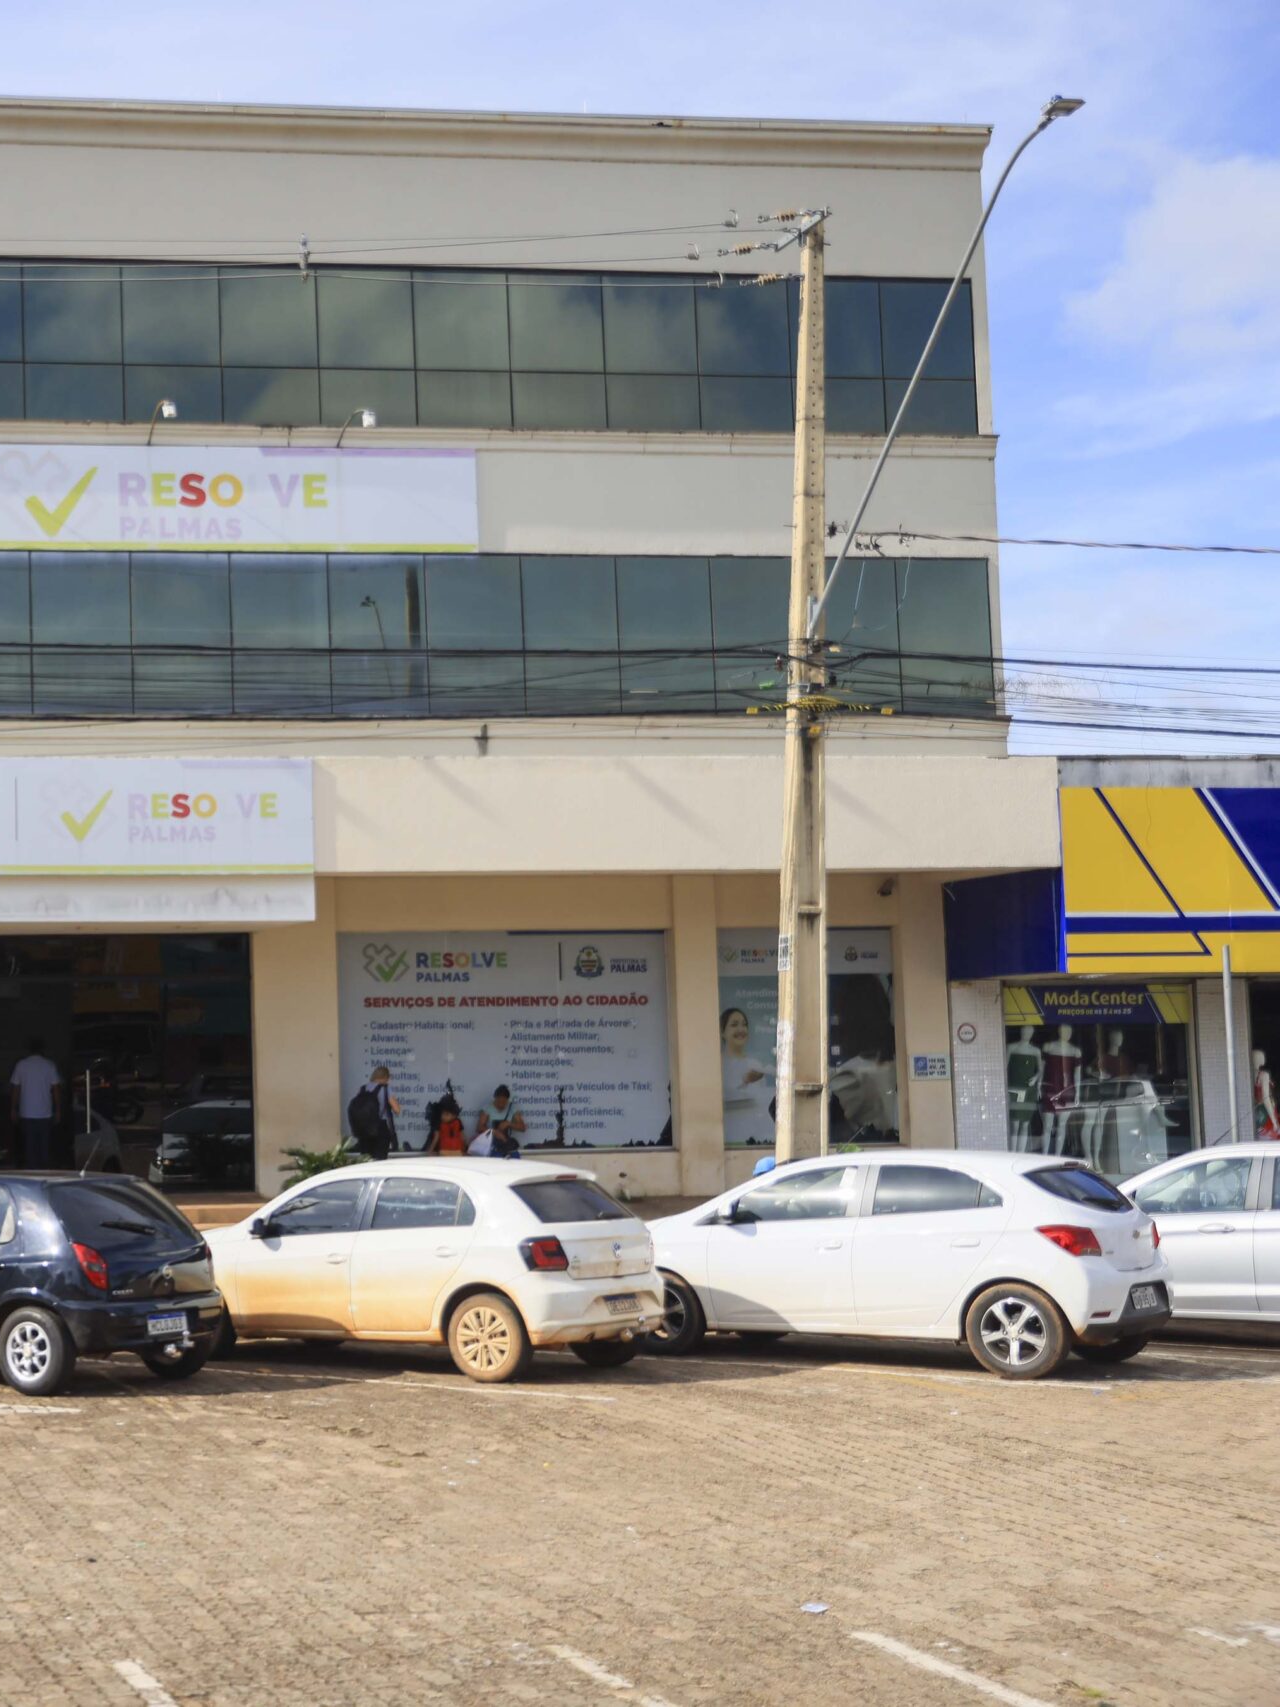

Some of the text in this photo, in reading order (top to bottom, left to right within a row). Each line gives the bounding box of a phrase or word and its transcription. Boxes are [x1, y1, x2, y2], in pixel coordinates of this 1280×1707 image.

[118, 472, 328, 508] RESOVE
[120, 517, 242, 539] PALMAS
[128, 793, 278, 819] RESOVE
[128, 826, 215, 843] PALMAS
[415, 952, 508, 969] RESOLVE
[610, 964, 647, 974] PALMAS
[416, 972, 470, 982] PALMAS
[364, 993, 648, 1009] SERVIÇOS DE ATENDIMENTO AO CIDADÃO
[1044, 990, 1144, 1006] Moda Center
[584, 1019, 595, 1028] de
[370, 1034, 408, 1043] Alvarás;
[510, 1032, 600, 1041] Alistamento Militar;
[524, 1045, 539, 1053] Via
[541, 1045, 552, 1053] de
[511, 1058, 574, 1067] Autorizações;
[512, 1083, 551, 1093] Serviços
[576, 1082, 615, 1091] Veículos
[618, 1082, 629, 1090] de
[512, 1096, 559, 1104] Credencia
